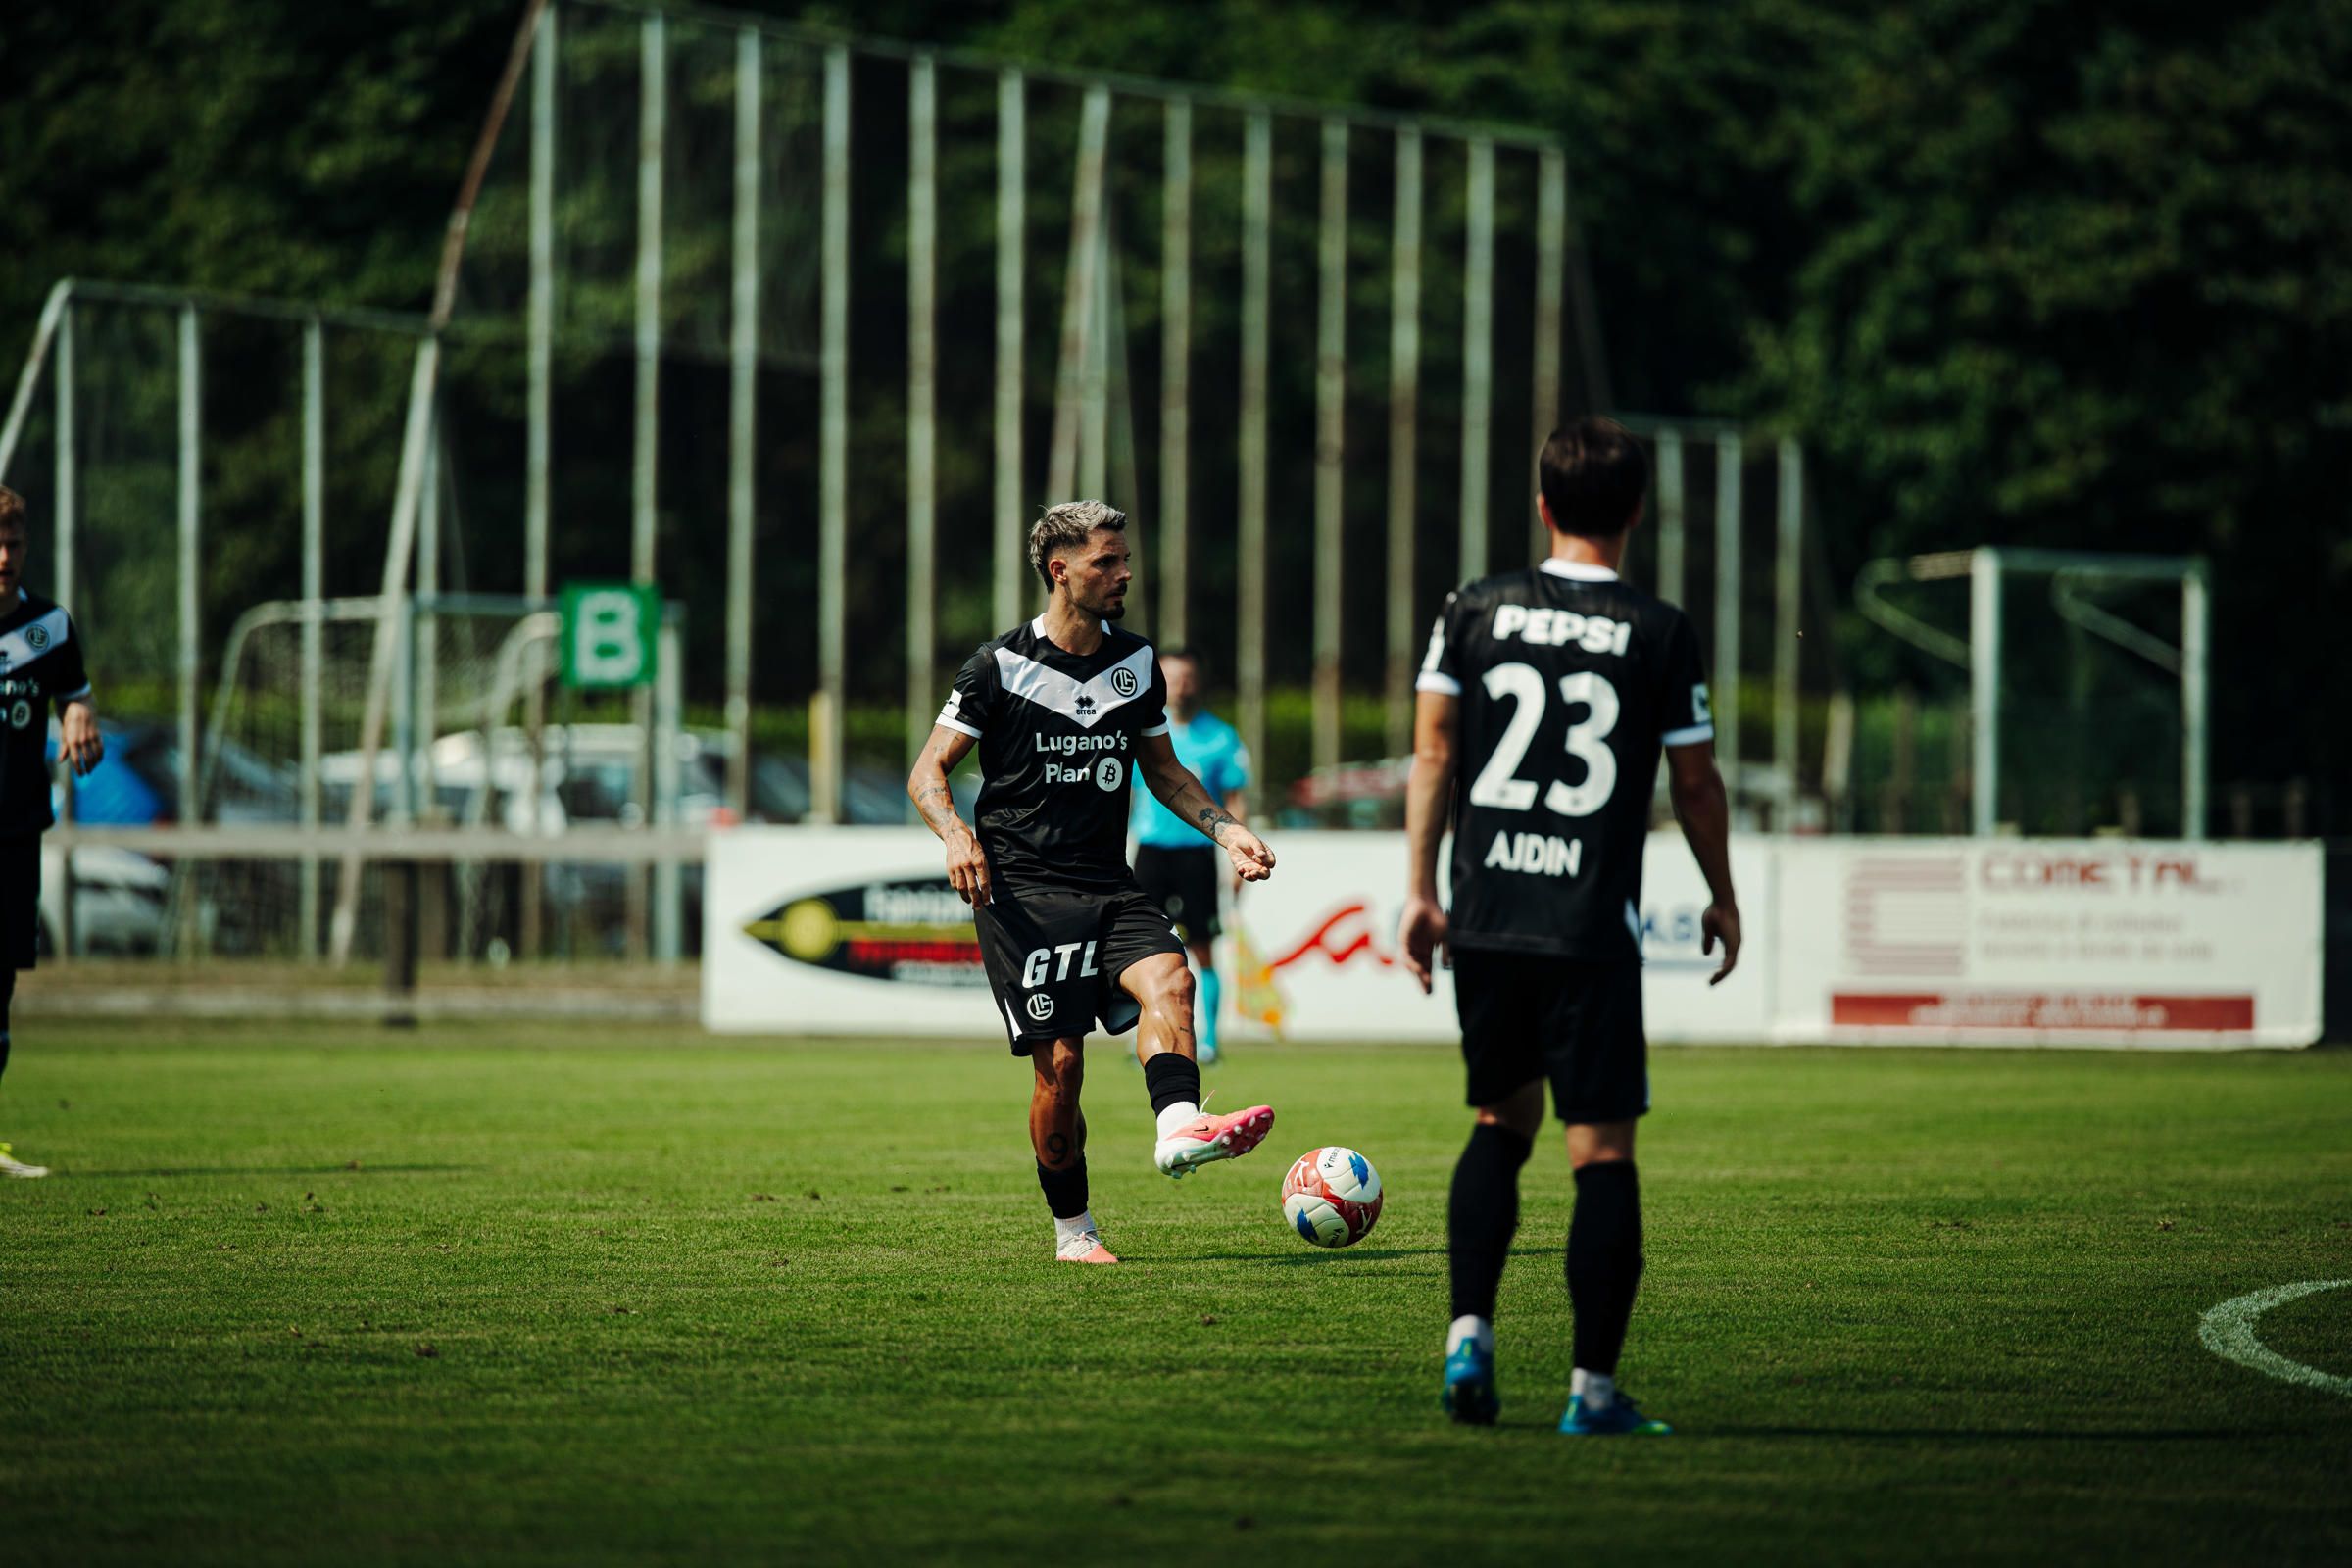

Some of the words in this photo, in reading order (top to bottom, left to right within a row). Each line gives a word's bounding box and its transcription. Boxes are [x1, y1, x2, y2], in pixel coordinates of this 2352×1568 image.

[574, 590, 644, 682] B
[1492, 604, 1632, 656] PEPSI
[1036, 730, 1128, 756] Lugano's
[1469, 662, 1620, 817] 23
[1045, 762, 1091, 784] Plan
[1484, 830, 1583, 877] AJDIN
[1022, 940, 1099, 989] GTL
